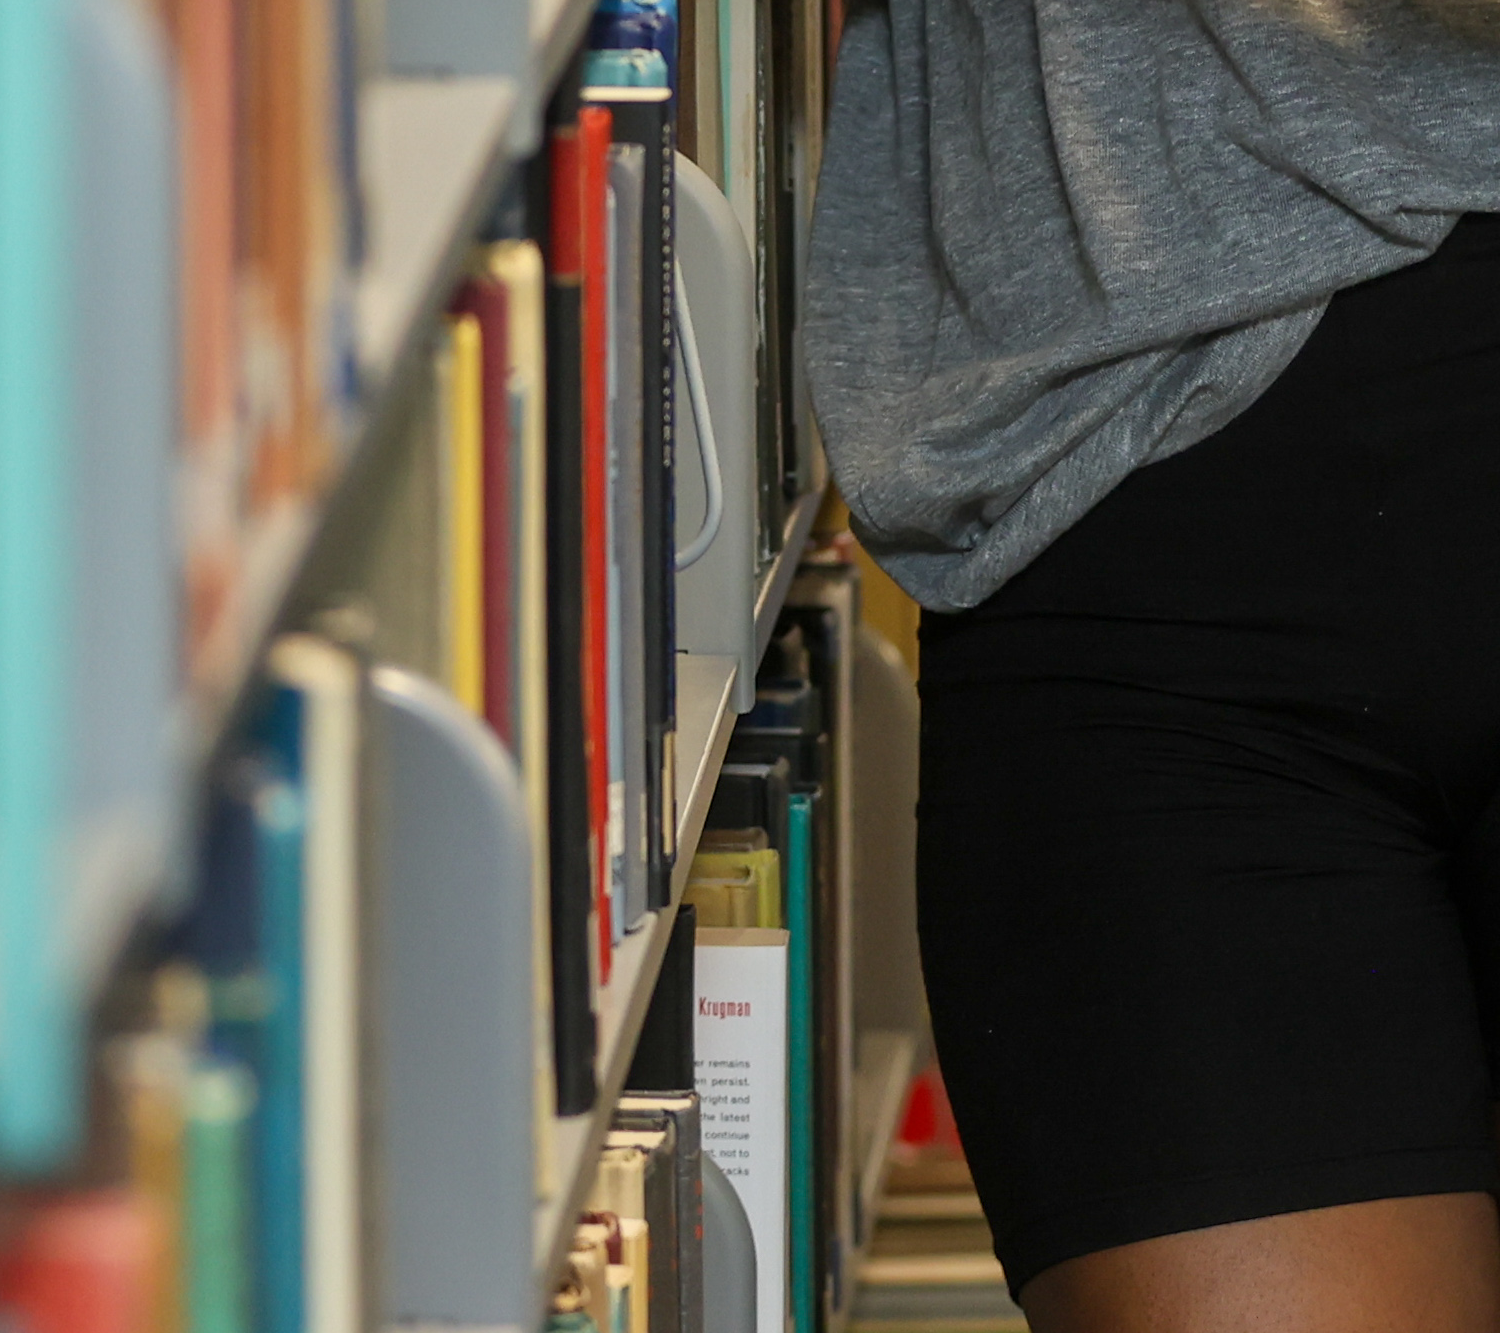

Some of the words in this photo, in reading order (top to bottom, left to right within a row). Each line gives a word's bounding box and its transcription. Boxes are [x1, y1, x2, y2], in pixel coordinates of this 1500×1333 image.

[698, 996, 751, 1020] Krugman
[708, 1059, 751, 1069] remains
[730, 1095, 751, 1105] and
[721, 1112, 750, 1123] latest
[704, 1131, 751, 1141] continue
[720, 1149, 736, 1159] not
[739, 1149, 750, 1159] to
